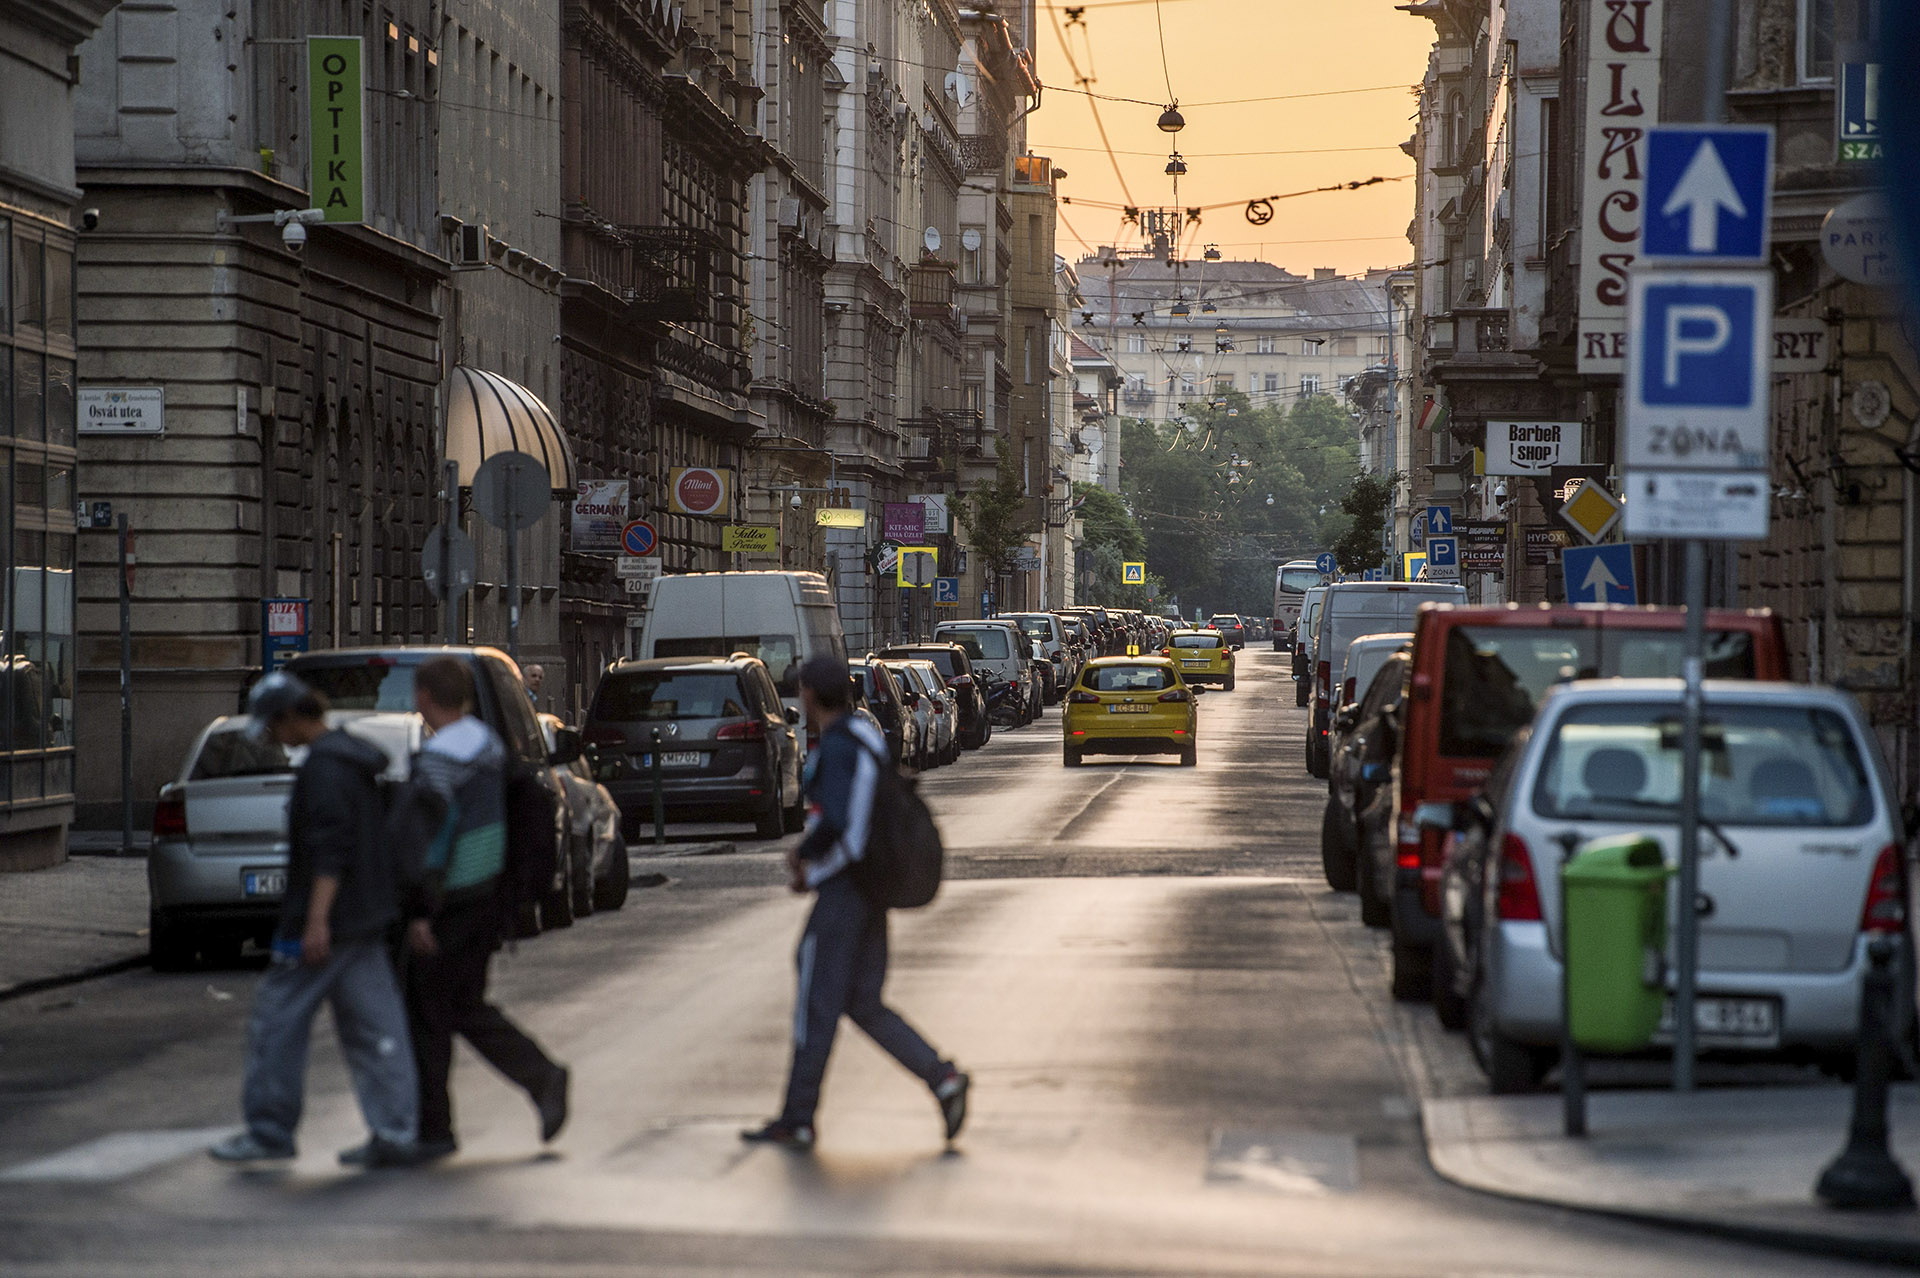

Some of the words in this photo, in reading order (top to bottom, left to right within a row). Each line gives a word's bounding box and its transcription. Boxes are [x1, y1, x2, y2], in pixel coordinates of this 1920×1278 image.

[322, 54, 348, 208] OPTIKA
[1664, 304, 1732, 388] P
[89, 404, 117, 418] Osvát
[1509, 424, 1561, 442] BarbeR
[1517, 445, 1552, 461] SHOP
[684, 479, 713, 490] Mimi
[575, 504, 627, 515] GERMANY
[732, 527, 766, 539] Tattoo
[889, 524, 920, 532] KIT-MIC
[729, 539, 767, 552] Piercing
[1435, 543, 1450, 561] P
[1432, 568, 1455, 576] ZÓNA
[629, 581, 642, 591] 20
[937, 580, 950, 601] P
[269, 602, 296, 613] 3072
